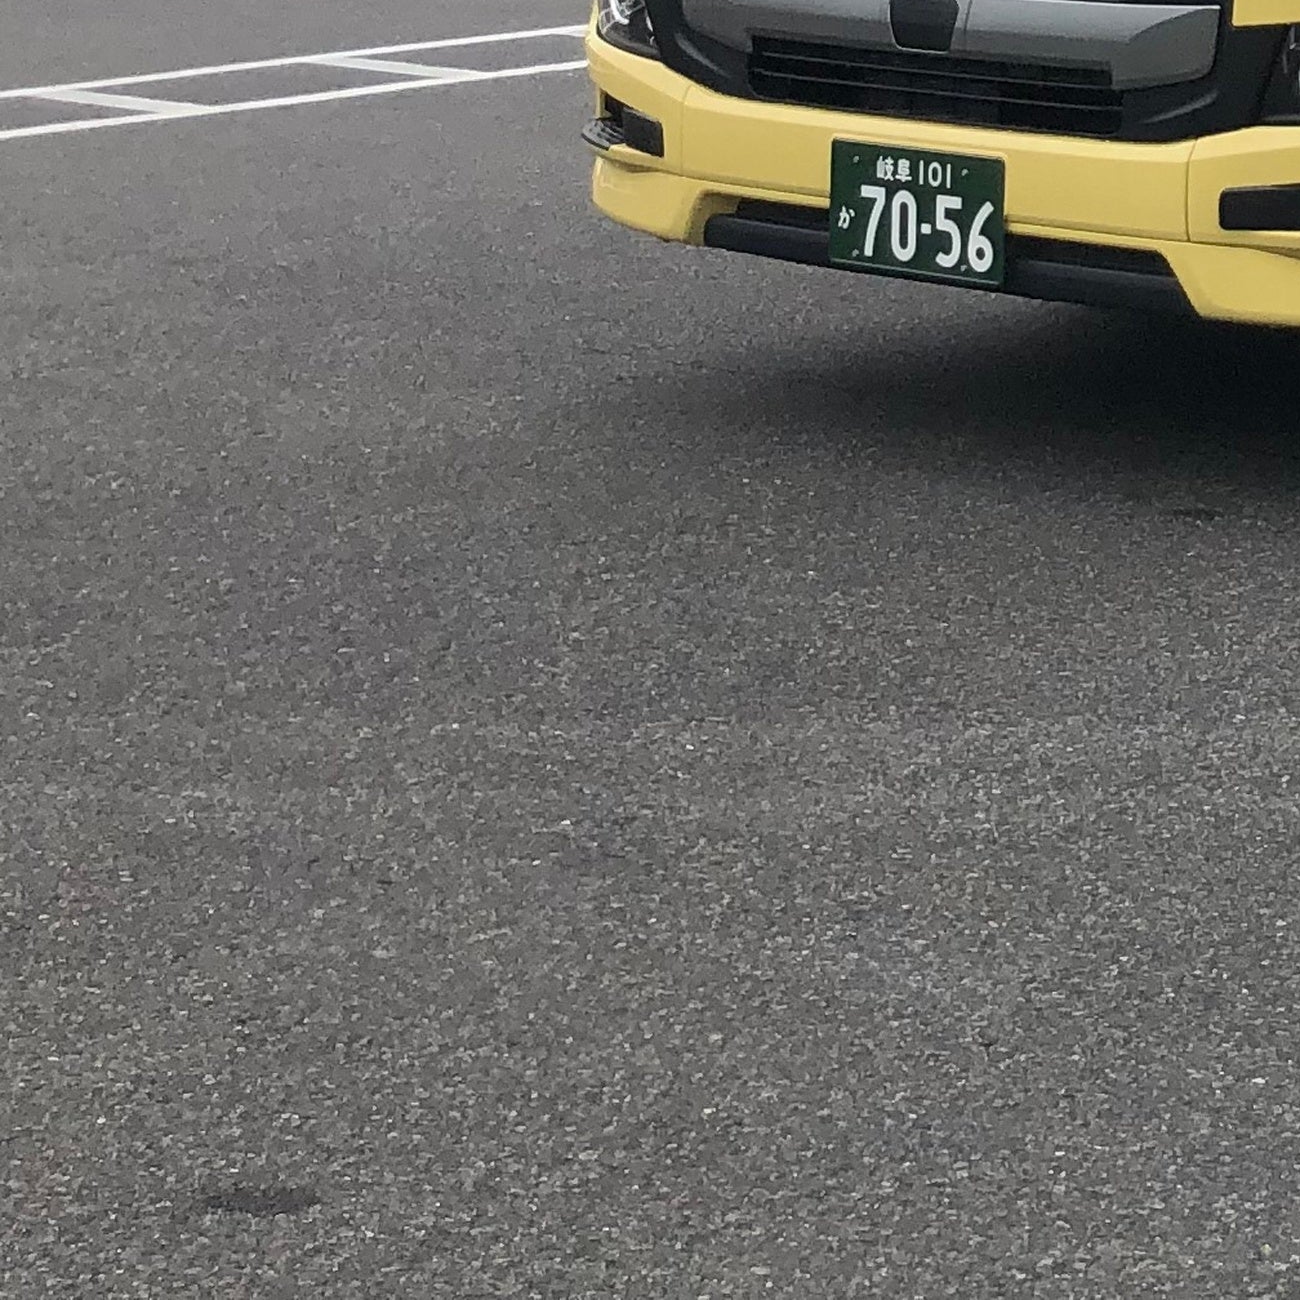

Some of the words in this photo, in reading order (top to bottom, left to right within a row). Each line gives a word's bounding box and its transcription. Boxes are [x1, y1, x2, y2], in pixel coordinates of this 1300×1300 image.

[876, 155, 912, 183] 岐阜
[919, 160, 951, 188] 101
[838, 205, 855, 229] か
[860, 184, 994, 273] 70-56
